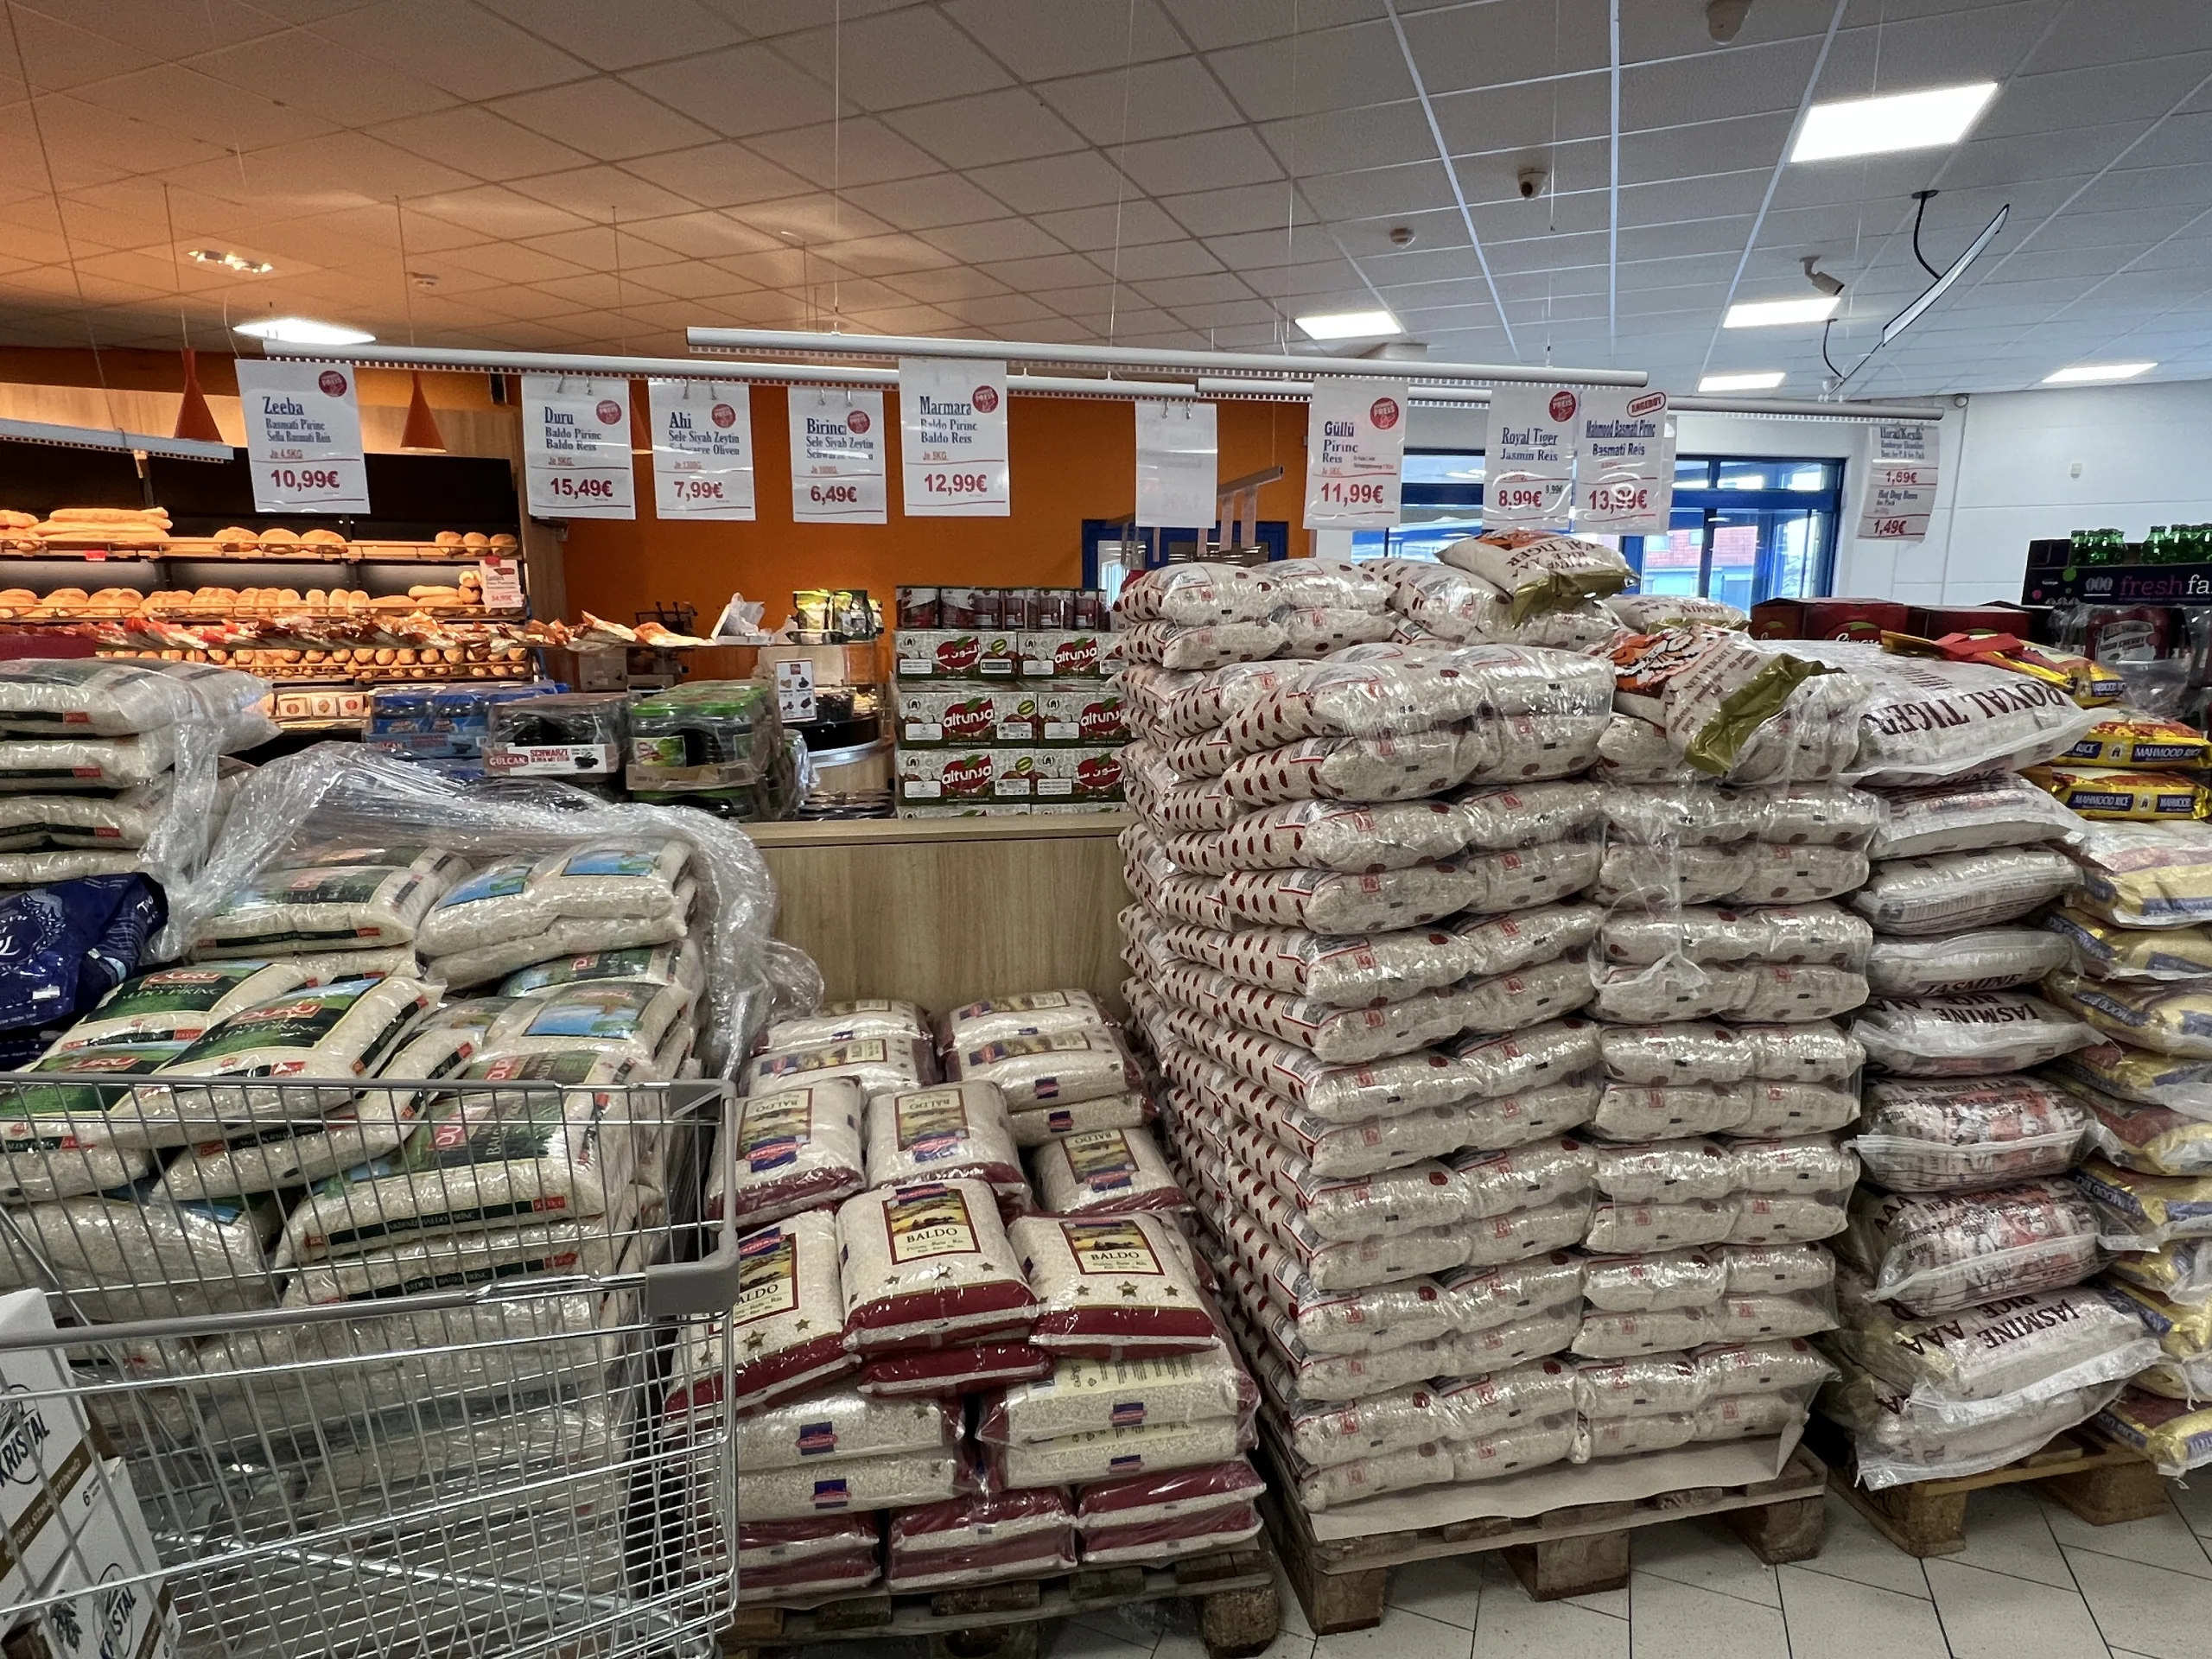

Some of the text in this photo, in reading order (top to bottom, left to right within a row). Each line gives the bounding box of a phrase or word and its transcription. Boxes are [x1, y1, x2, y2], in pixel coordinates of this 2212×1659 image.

[263, 397, 304, 415] Zeeba
[919, 396, 972, 416] Marmara
[266, 418, 298, 429] Basmati
[544, 407, 574, 424] Duru
[670, 412, 692, 429] Ahi
[545, 427, 601, 440] Baldo Pirinc
[806, 418, 847, 435] Birinci
[950, 419, 977, 431] Pirinc
[1324, 421, 1354, 437] Güllü
[546, 438, 596, 451] Baldo Reis
[669, 431, 740, 444] Sele Siyah Zeytin
[806, 436, 874, 449] Sele Siyah Zeytin
[921, 432, 973, 444] Baldo Reis
[1502, 427, 1558, 448] Royal Tiger
[714, 445, 740, 455] Oliven
[1323, 439, 1358, 454] Pirinc
[1500, 448, 1558, 461] Jasmin Reis
[1592, 443, 1645, 456] Basmati Reis
[1322, 453, 1343, 464] Reis
[271, 469, 340, 492] 10,99€
[550, 478, 613, 499] 15,49€
[924, 474, 988, 497] 12,99€
[674, 481, 723, 501] 7,99€
[810, 486, 857, 505] 6,49€
[1321, 482, 1383, 507] 11,99€
[1890, 490, 1902, 500] Dog
[1498, 490, 1542, 510] 8,99€
[1874, 519, 1907, 537] 1,49€
[1506, 541, 1561, 566] TIGER
[2120, 574, 2212, 595] fresh fa
[1054, 646, 1097, 664] altunsa
[1960, 680, 2066, 718] ROYAL
[943, 709, 995, 728] altunsa
[1080, 710, 1121, 727] altuns
[2135, 747, 2183, 757] MAHMOOD
[942, 766, 992, 785] altunsa
[2074, 795, 2114, 805] MAHMOOD
[1922, 973, 2022, 995] JASMINE
[1931, 1003, 2039, 1023] JASMINE
[756, 1100, 798, 1112] BALDO
[1075, 1132, 1112, 1144] BALDO
[906, 1228, 957, 1243] BALDO
[1090, 1251, 1140, 1261] BALDO
[736, 1284, 779, 1306] ALDO
[1976, 1299, 2081, 1350] JASMINE
